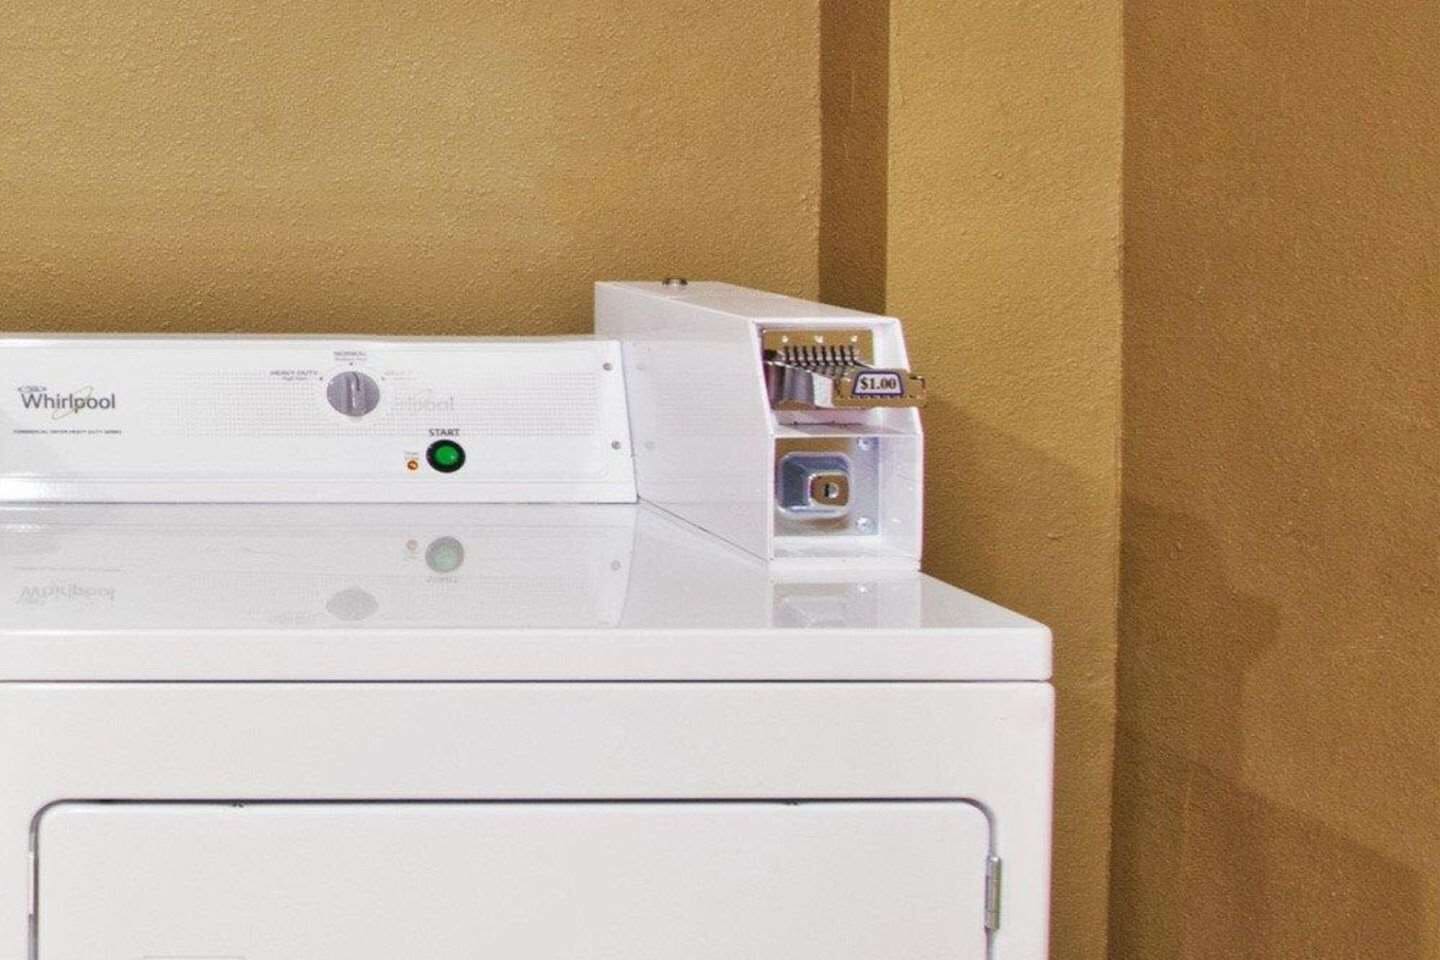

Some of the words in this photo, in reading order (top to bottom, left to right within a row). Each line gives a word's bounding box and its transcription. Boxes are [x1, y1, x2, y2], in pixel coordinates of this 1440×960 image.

[860, 376, 897, 390] $1.00
[20, 393, 116, 414] Whirlpool
[428, 428, 461, 437] START
